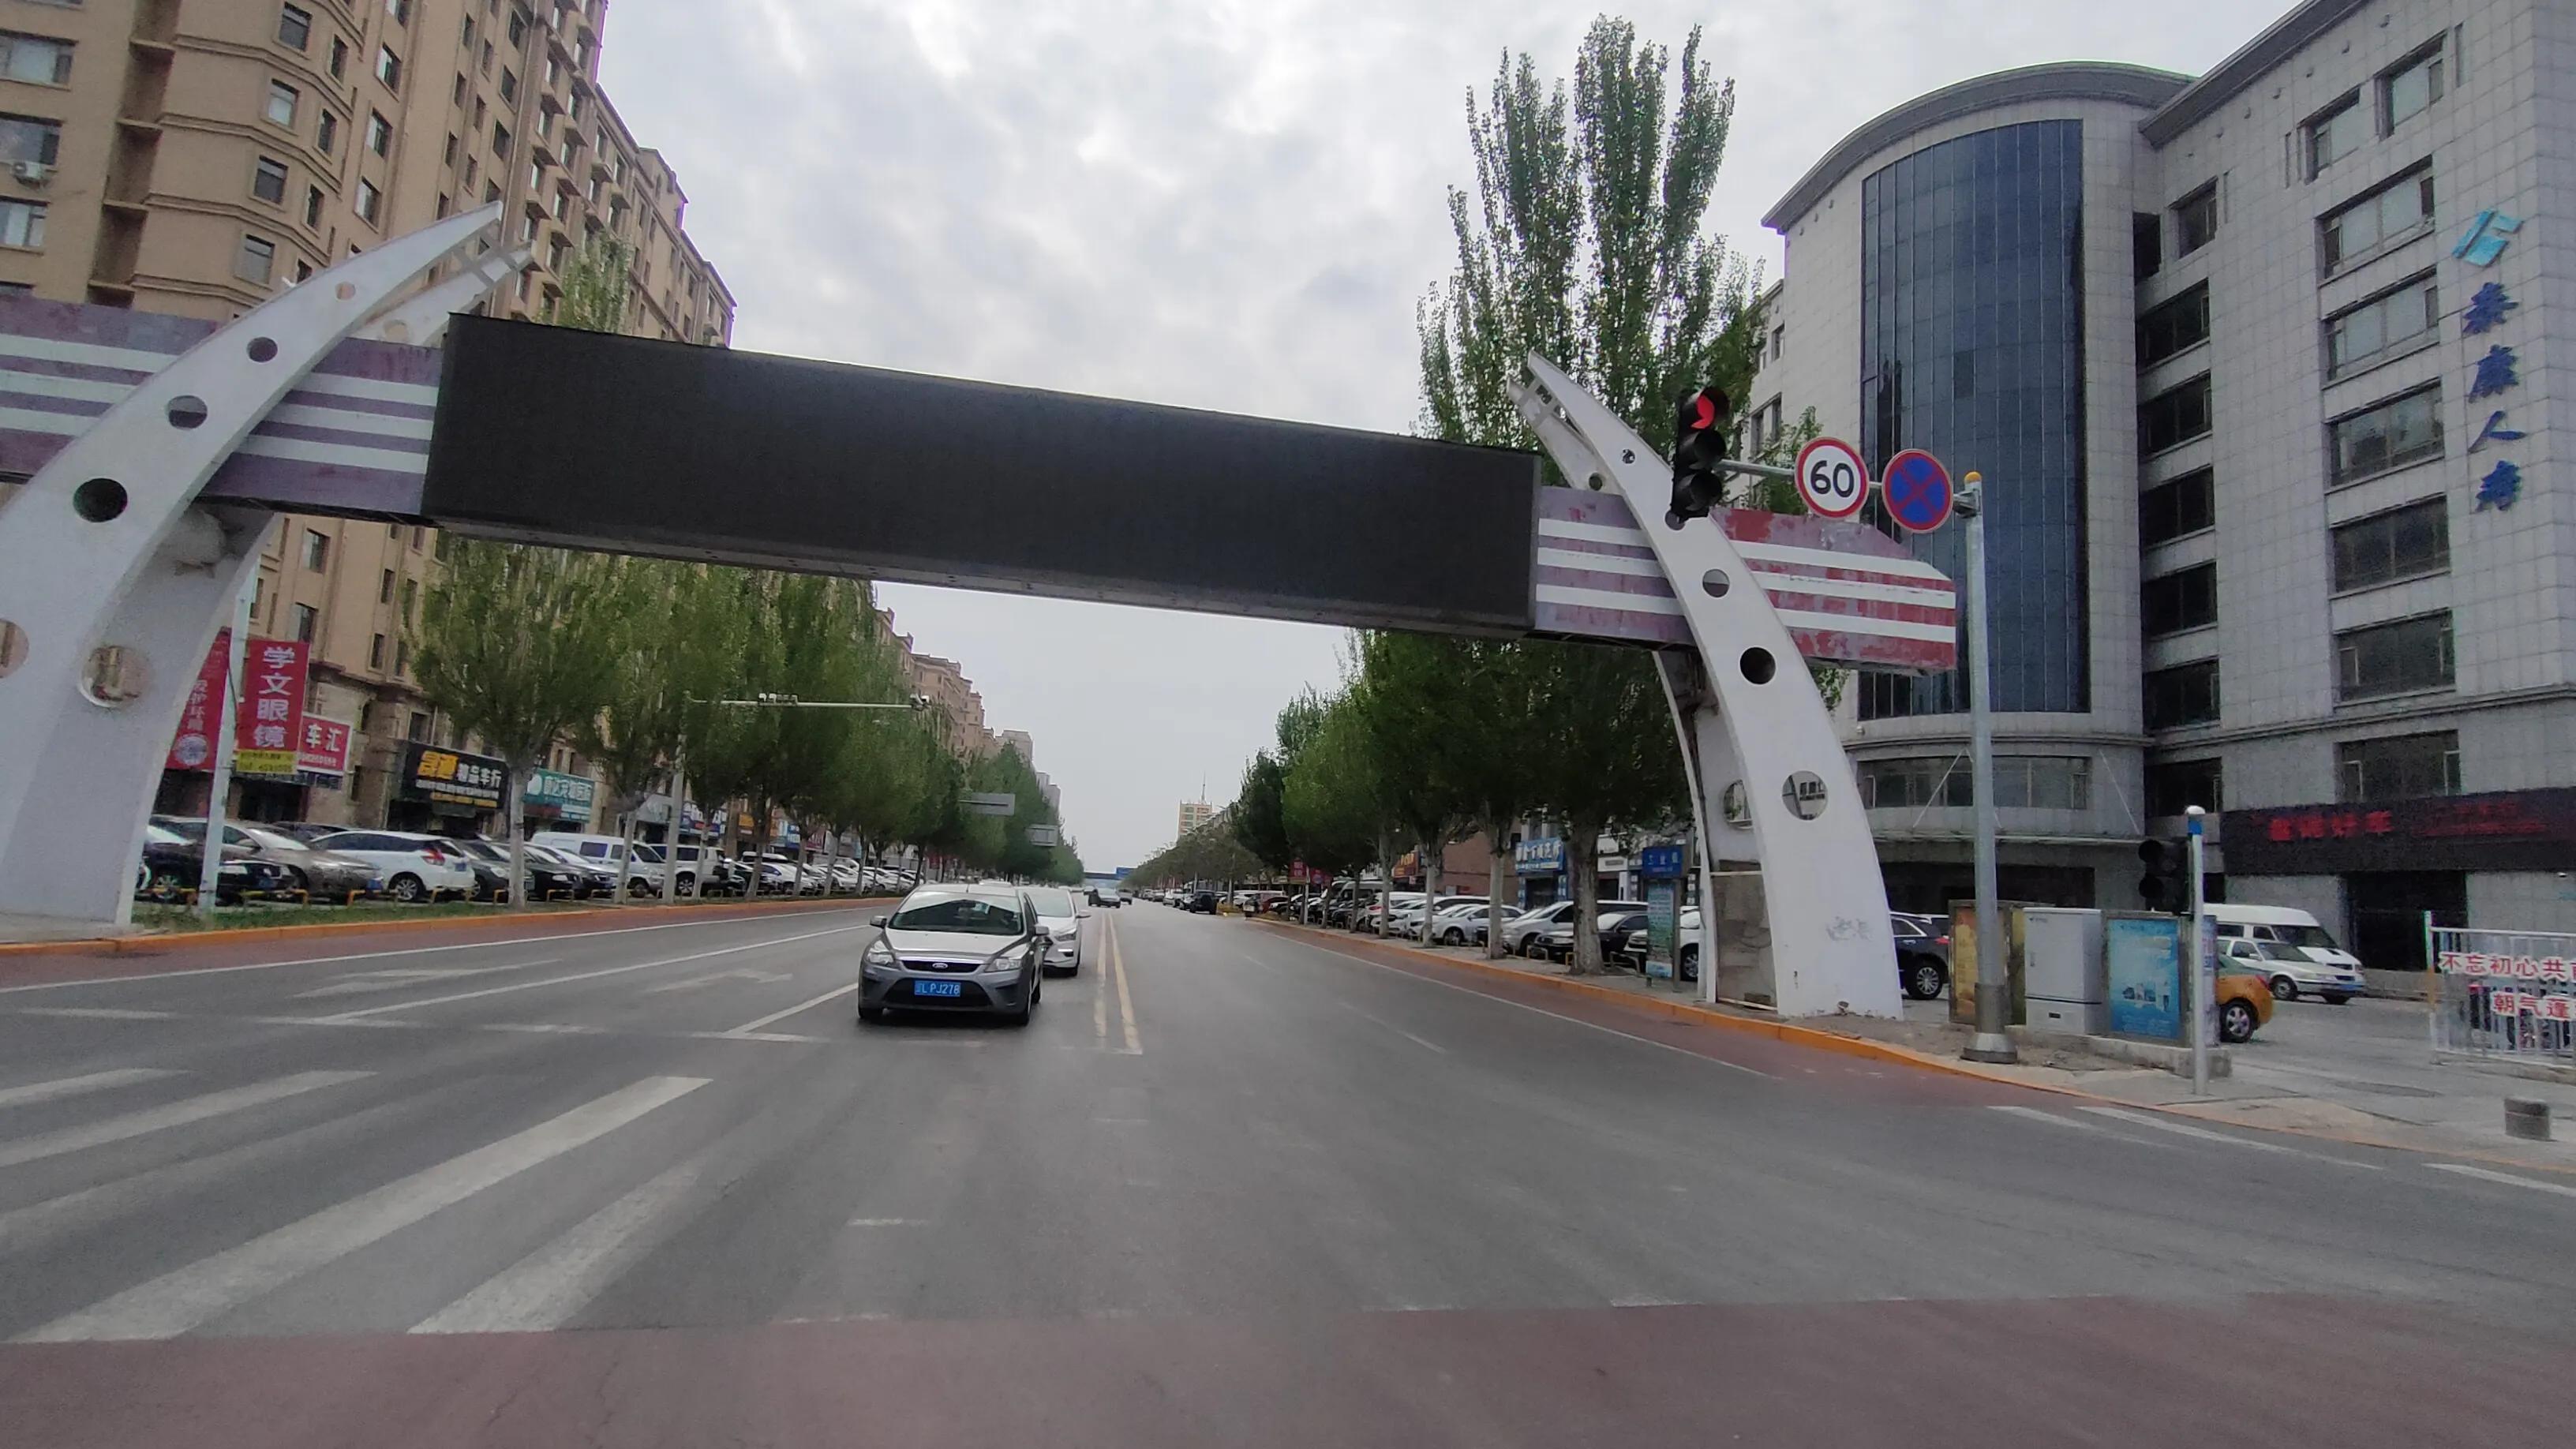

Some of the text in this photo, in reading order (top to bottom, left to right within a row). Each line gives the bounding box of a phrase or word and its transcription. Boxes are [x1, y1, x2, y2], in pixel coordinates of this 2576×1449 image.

[1810, 459, 1855, 498] 60
[253, 646, 295, 748] 学文眼镜
[305, 722, 343, 752] 车汇
[2493, 993, 2576, 1020] 朝气蓬
